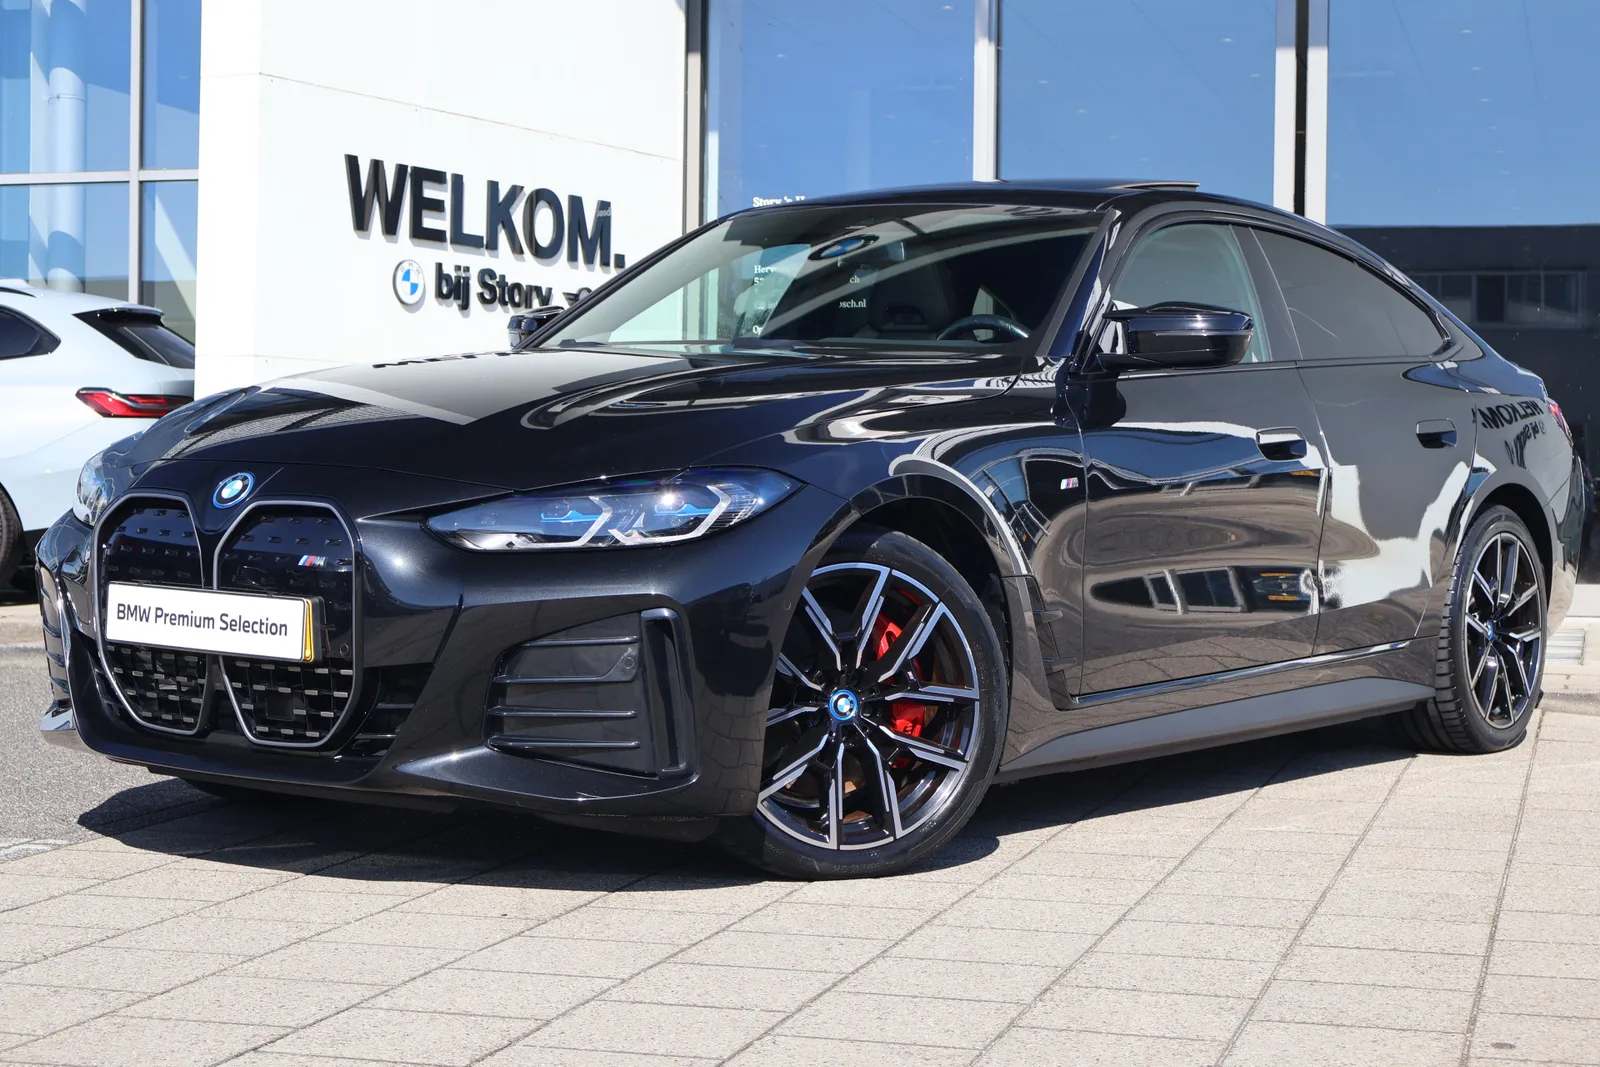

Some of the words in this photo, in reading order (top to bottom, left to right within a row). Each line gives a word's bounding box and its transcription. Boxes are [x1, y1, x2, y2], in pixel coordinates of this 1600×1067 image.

[344, 153, 626, 270] WELKOM.
[435, 262, 471, 311] bij
[116, 602, 151, 623] BMW
[154, 606, 215, 630] Premium
[219, 613, 288, 637] Selection
